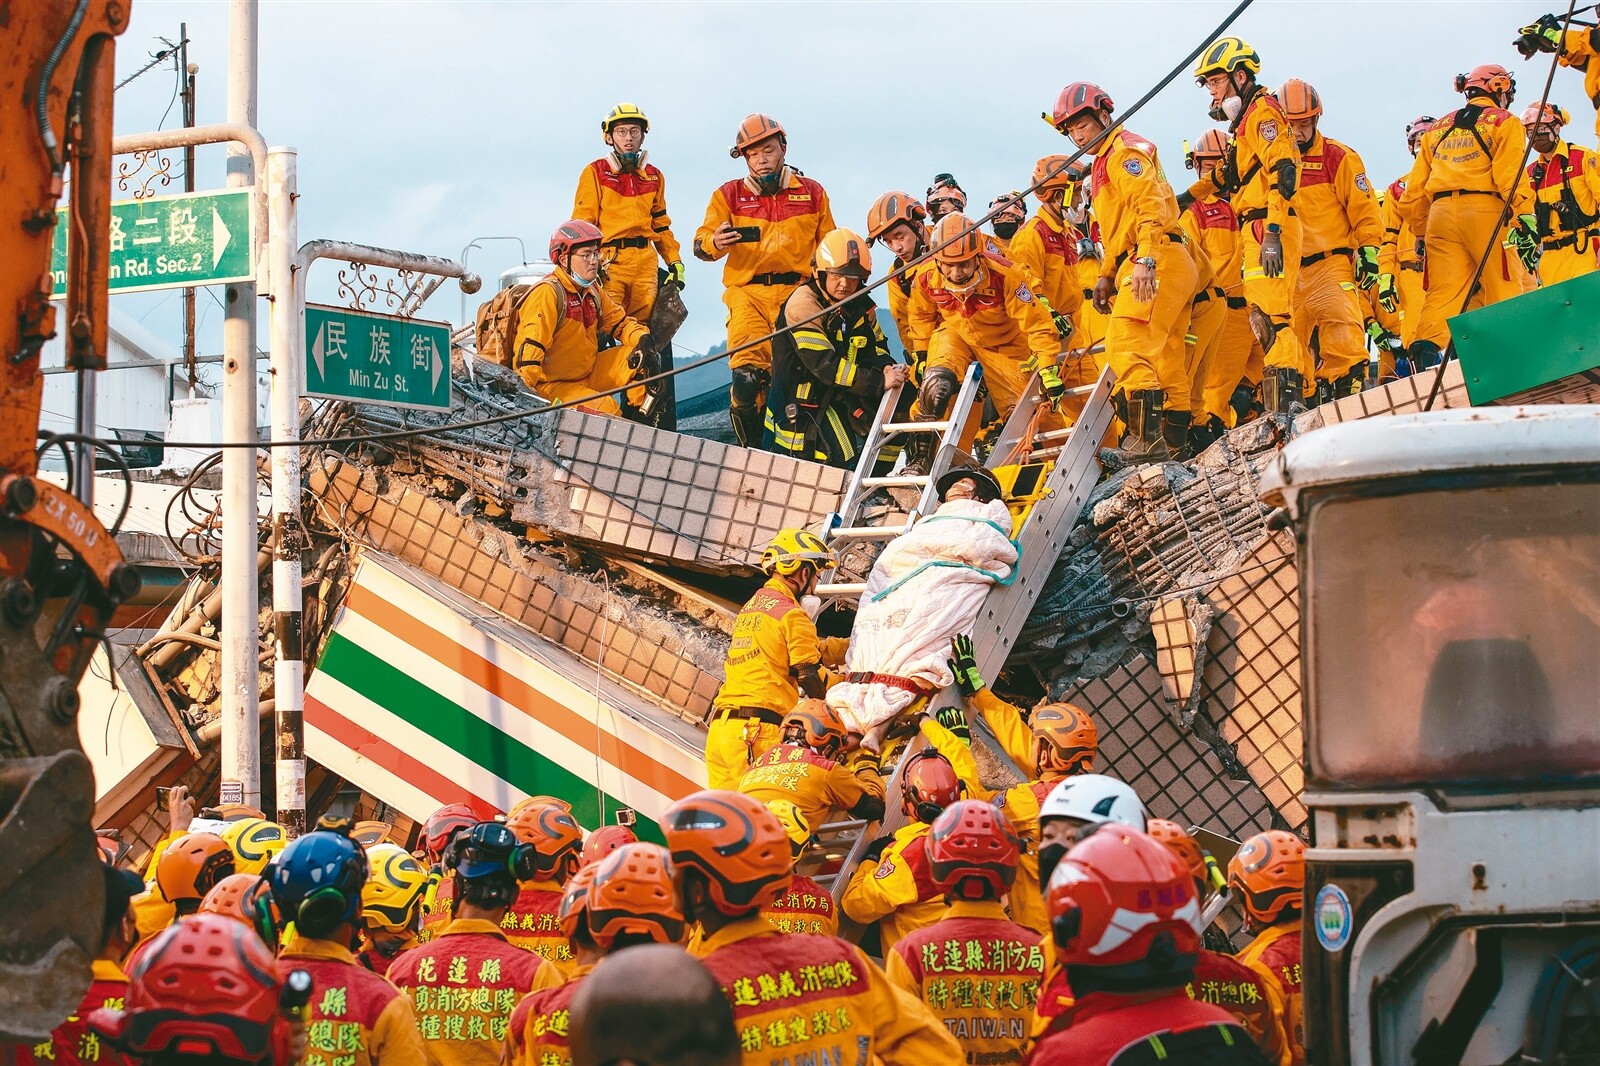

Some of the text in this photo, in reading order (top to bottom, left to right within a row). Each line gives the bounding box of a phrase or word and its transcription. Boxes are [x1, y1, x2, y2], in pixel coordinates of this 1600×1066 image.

[125, 258, 152, 278] Rd.
[156, 252, 203, 275] Sec.2
[325, 320, 431, 372] 民族街
[350, 369, 409, 392] Min Zu St.
[518, 943, 575, 962] 救隊
[921, 939, 1044, 973] 花蓮縣消防局
[416, 956, 501, 984] 花蓮縣
[722, 960, 858, 1007] 蓮縣義消總隊
[319, 986, 347, 1017] 縣
[400, 984, 516, 1014] 勇消防總隊
[928, 977, 1039, 1011] 特種搜救隊
[304, 1018, 366, 1053] 總隊
[415, 1013, 509, 1041] 種搜救隊
[741, 1006, 852, 1052] 特種搜救隊
[944, 1017, 1025, 1038] TAIWAN
